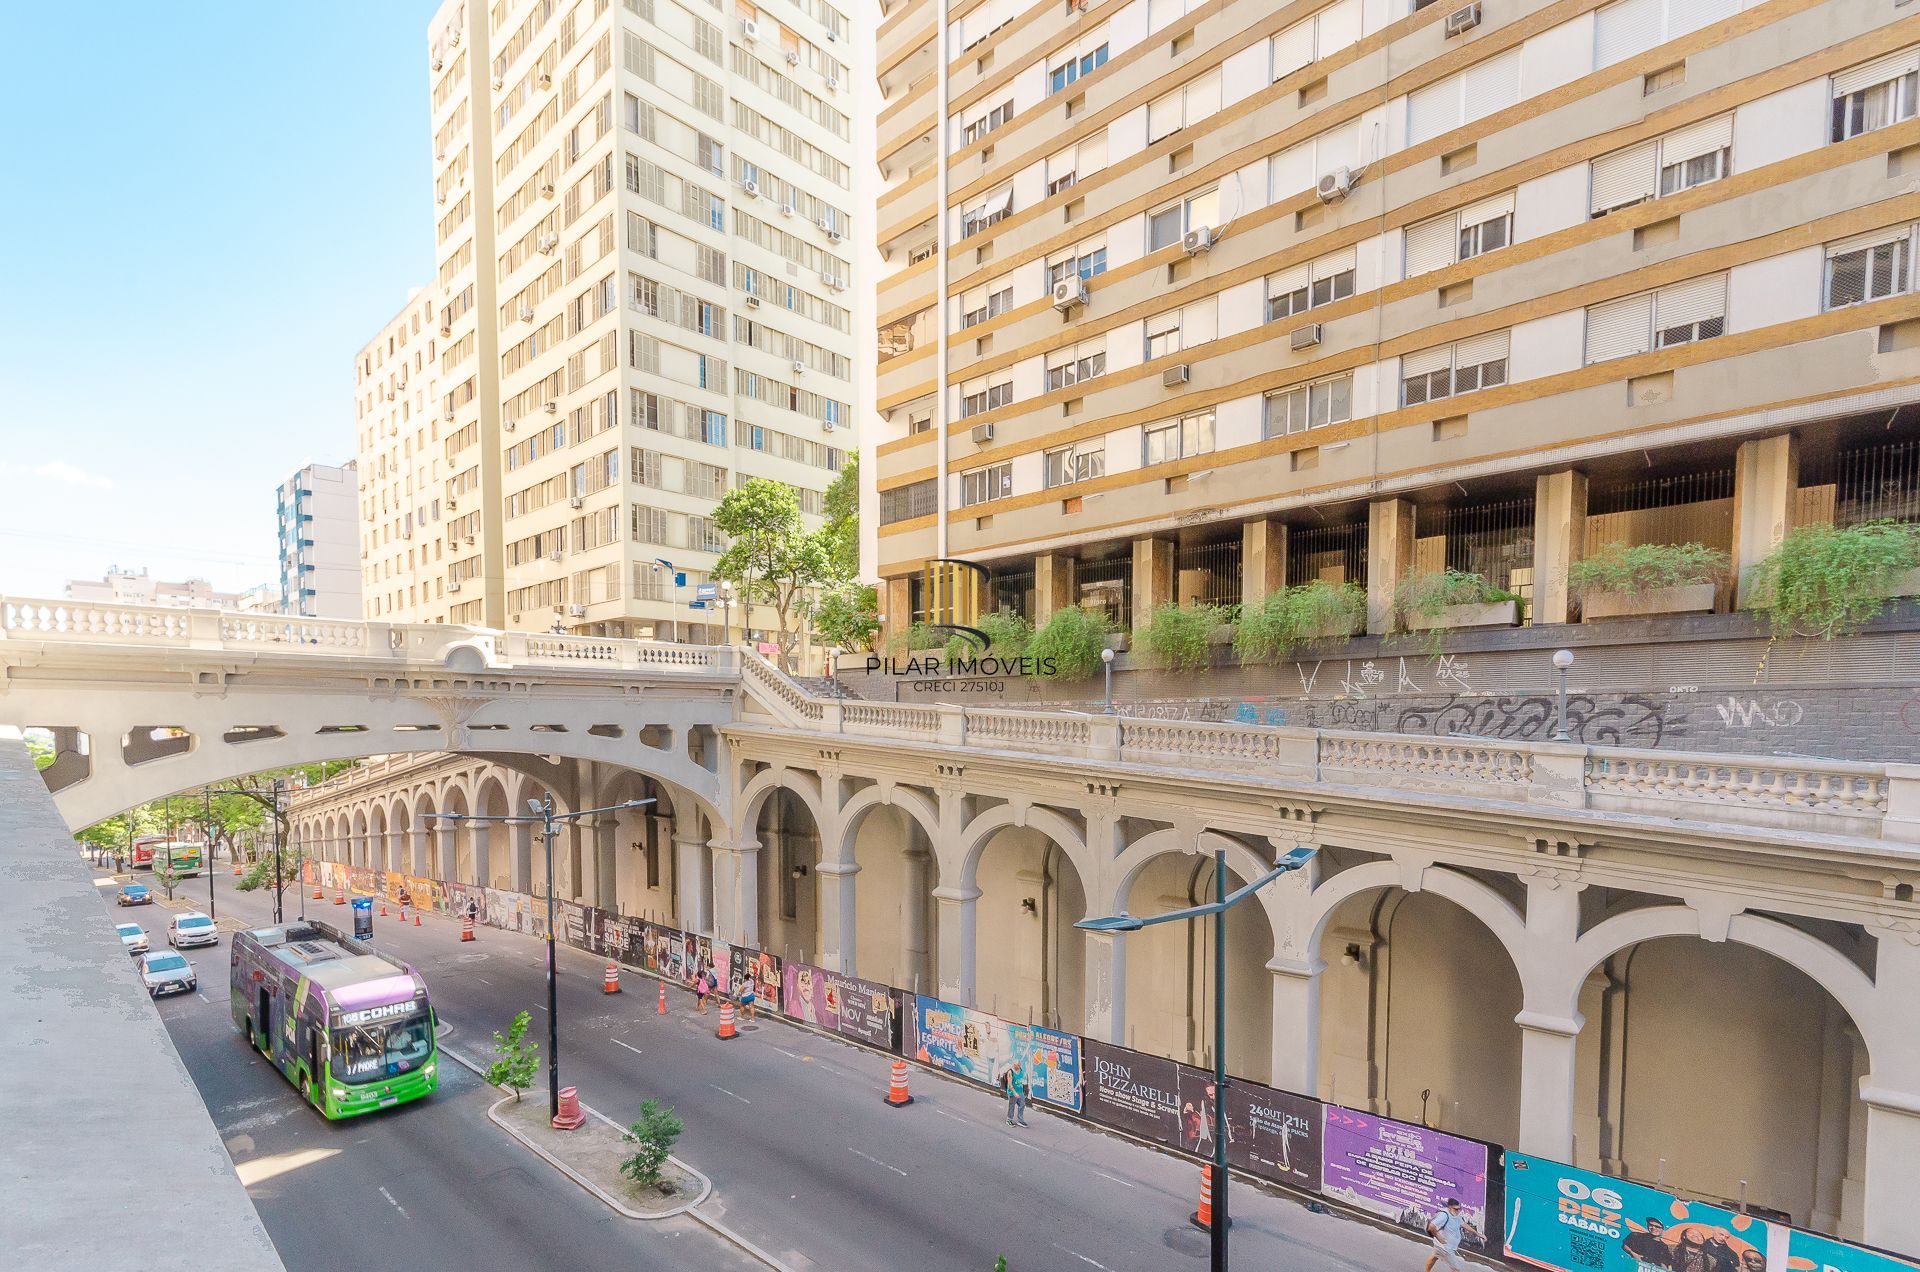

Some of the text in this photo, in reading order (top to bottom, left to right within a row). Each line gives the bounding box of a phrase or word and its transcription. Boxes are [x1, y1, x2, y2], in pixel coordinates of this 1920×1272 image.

[841, 1007, 861, 1022] NOV
[1094, 1056, 1131, 1079] JOHN
[1099, 1071, 1180, 1107] PIZZARELLI
[1131, 1095, 1150, 1107] Stage
[1285, 1114, 1309, 1131] 21H
[1557, 1177, 1623, 1210] 06
[1558, 1197, 1622, 1228] DEZ
[1558, 1212, 1621, 1239] SÁBADO
